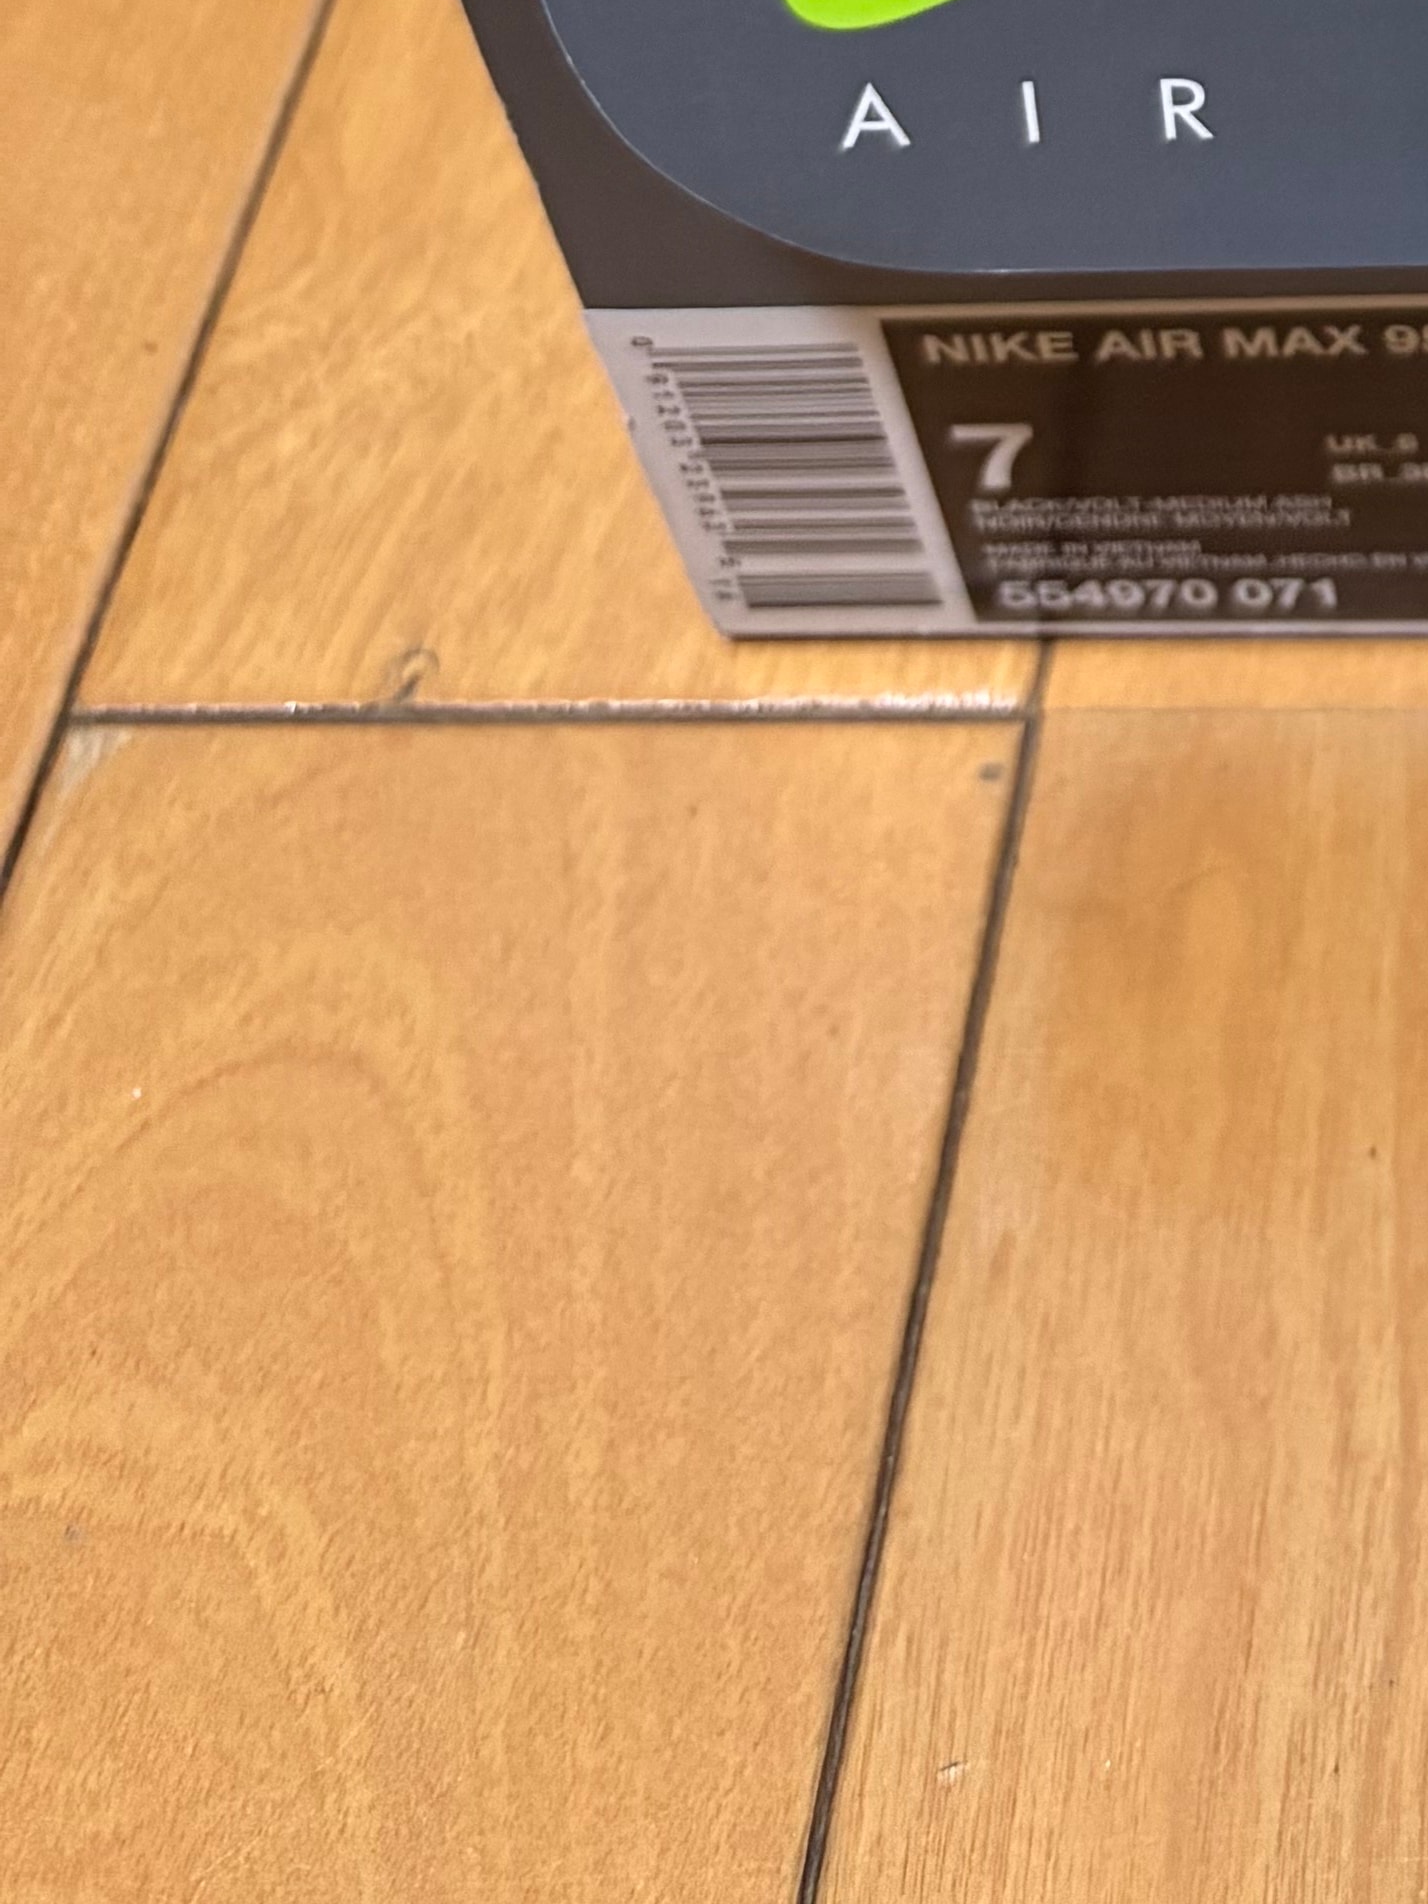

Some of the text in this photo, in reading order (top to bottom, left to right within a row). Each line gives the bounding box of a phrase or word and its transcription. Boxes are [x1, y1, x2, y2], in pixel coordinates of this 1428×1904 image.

[841, 79, 1213, 150] AIR
[922, 330, 1078, 364] NIKE
[1097, 328, 1203, 361] AIR
[1224, 325, 1367, 358] MAX
[947, 422, 1034, 490] 7
[1000, 577, 1337, 610] 554970 071
